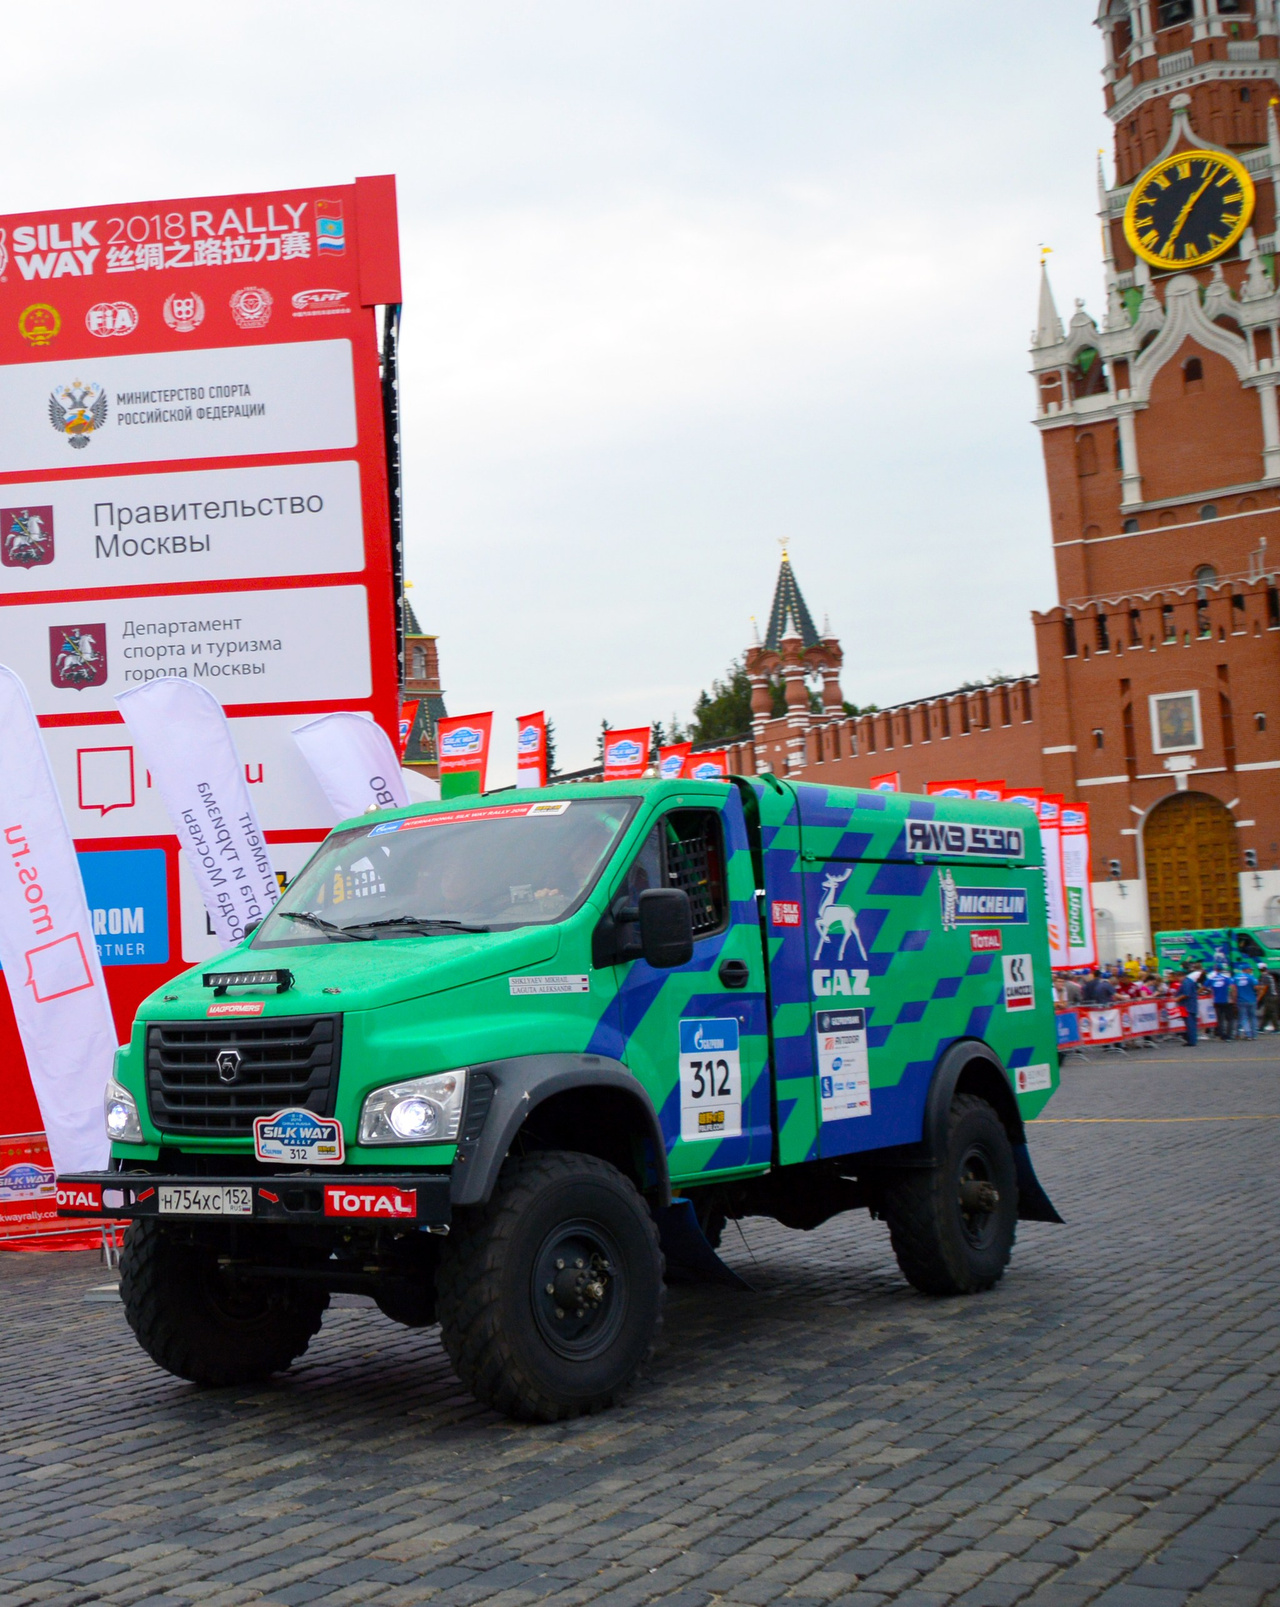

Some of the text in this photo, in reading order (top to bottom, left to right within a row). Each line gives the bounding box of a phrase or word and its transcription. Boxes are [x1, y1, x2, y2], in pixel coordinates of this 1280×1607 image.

[12, 202, 308, 252] SILK 2018 RALLY
[106, 231, 311, 274] 丝绸之路拉力赛
[14, 249, 101, 281] WAY
[116, 384, 252, 406] МИНИСТЕРСТВО СПОРТА
[117, 403, 266, 426] РОССИЙСКОЙ ФЕДЕРАЦИИ
[93, 494, 324, 532] Правительство
[95, 534, 211, 559] Москвы
[122, 618, 242, 639] Департамент
[123, 638, 282, 661] спорта и туризма
[193, 662, 266, 679] Москвы
[404, 815, 454, 826] INTERNATIONAL
[967, 827, 1021, 856] 530
[783, 904, 799, 913] SILK
[959, 895, 1025, 913] MICHELIN
[783, 914, 799, 923] WAY
[96, 942, 145, 957] RTNER
[970, 934, 1001, 948] TOTAL
[512, 985, 572, 994] LAGUTA ALEKSANDR
[812, 969, 871, 996] GAZ
[209, 1004, 261, 1014] MAGFORMERS
[690, 1059, 731, 1099] 312
[263, 1126, 332, 1139] SILK WAY
[289, 1149, 307, 1160] 312
[26, 1174, 53, 1184] WAY
[56, 1191, 99, 1207] OTAL
[224, 1188, 249, 1205] 152
[328, 1190, 412, 1214] TOTAL
